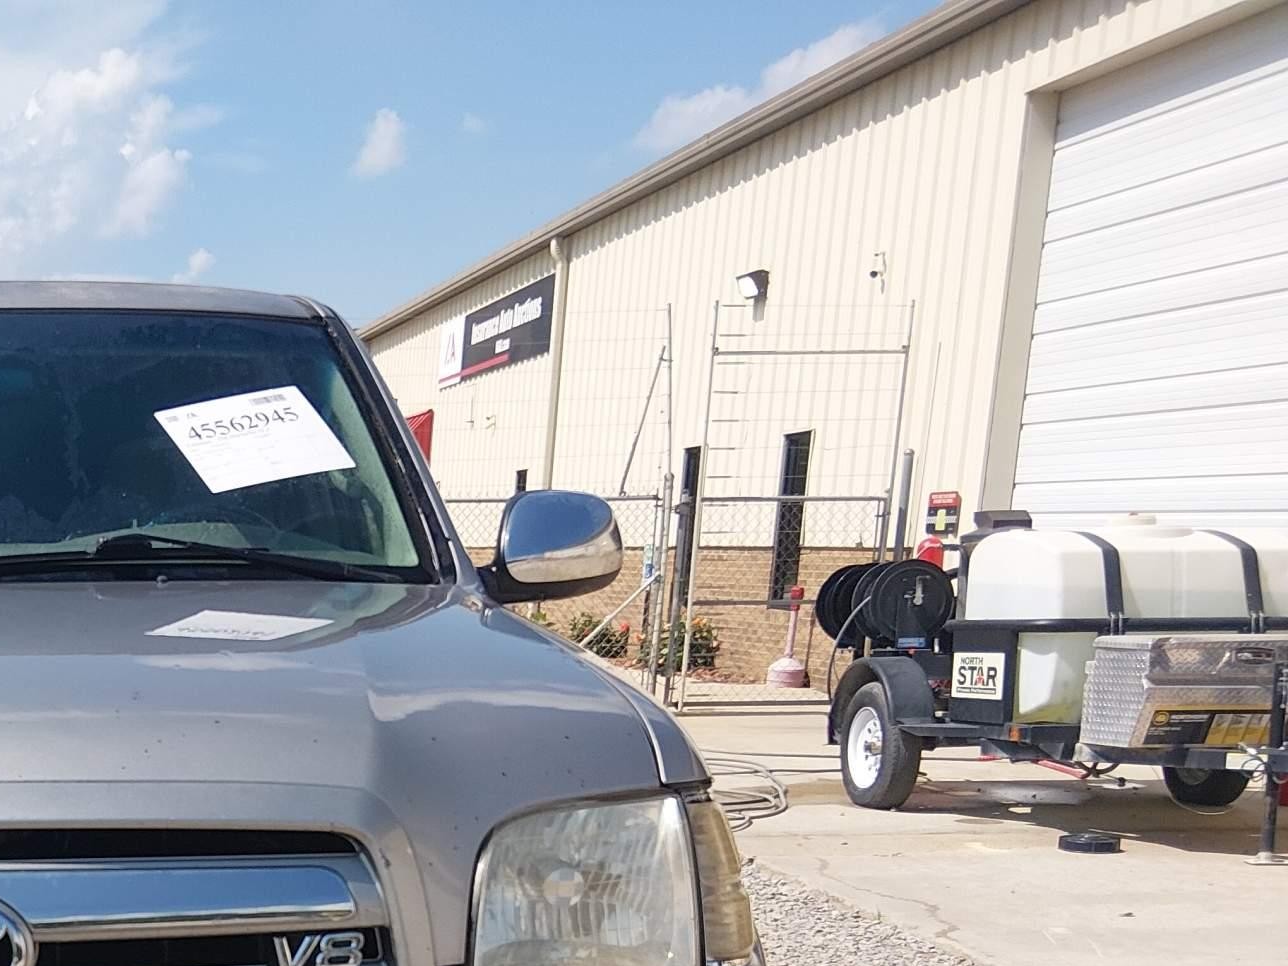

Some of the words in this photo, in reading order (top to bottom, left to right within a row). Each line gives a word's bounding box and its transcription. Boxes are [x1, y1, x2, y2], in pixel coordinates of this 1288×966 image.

[187, 406, 300, 441] 45562945
[960, 656, 984, 666] NORTH
[957, 665, 998, 687] STAR
